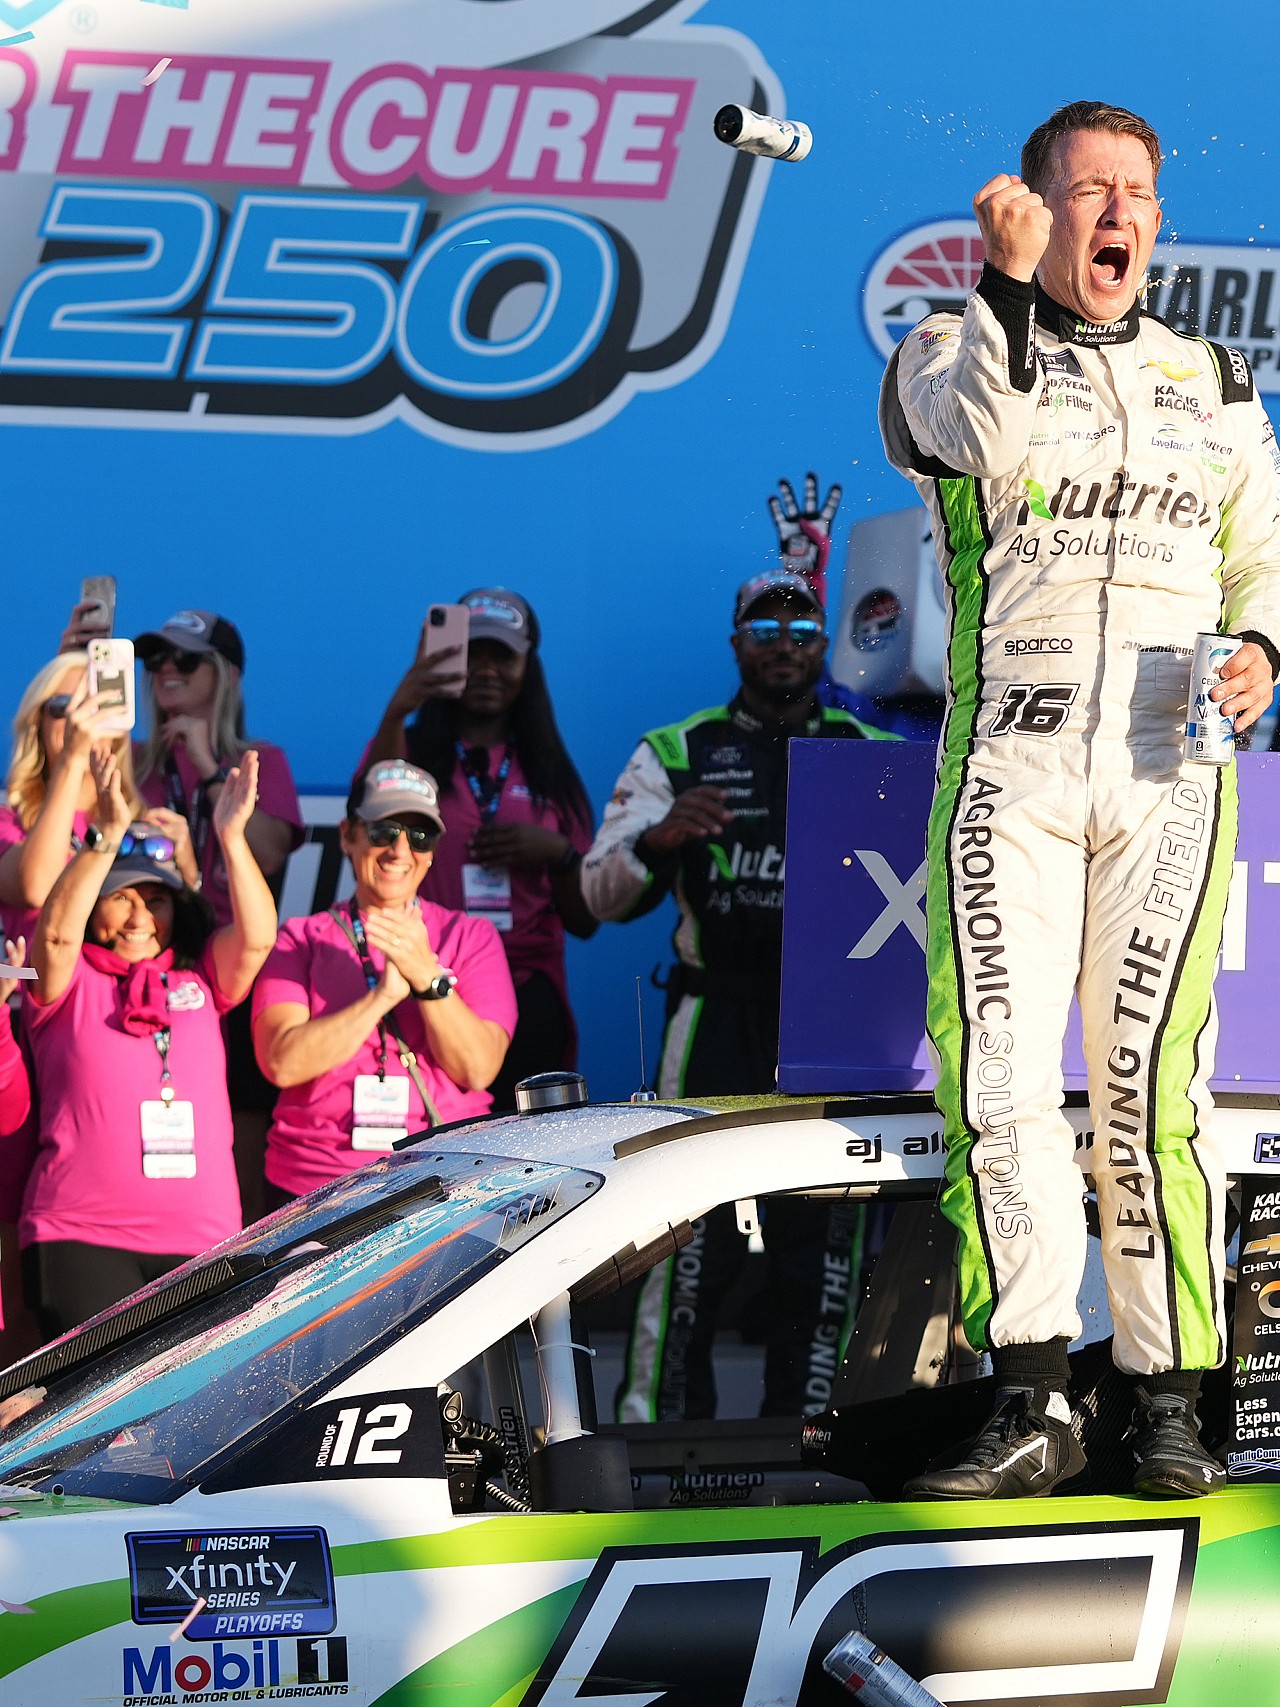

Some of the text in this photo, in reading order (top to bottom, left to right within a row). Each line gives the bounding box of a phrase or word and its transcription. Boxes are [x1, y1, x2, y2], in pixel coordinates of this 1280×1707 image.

[68, 62, 314, 169] THE
[340, 74, 679, 185] CURE
[2, 183, 619, 397] 250
[1075, 320, 1128, 335] Nutrien
[1004, 529, 1175, 563] Ag Solutions
[1004, 636, 1073, 656] sparco
[1122, 640, 1194, 656] Allmendinge
[988, 683, 1081, 738] 16
[958, 776, 1013, 1022] AGRONOMIC
[1107, 780, 1208, 1260] LEADING THE FIELD
[845, 1132, 883, 1164] aj
[803, 1323, 839, 1417] ADING
[821, 1252, 850, 1315] THE
[1233, 1374, 1248, 1388] Ag
[1235, 1397, 1269, 1413] Less
[315, 1424, 337, 1467] ROUND OF
[330, 1402, 413, 1467] 12
[690, 1487, 749, 1501] Solutions
[206, 1536, 270, 1551] NASCAR
[166, 1555, 297, 1599] xfinity
[206, 1592, 260, 1609] SERIES
[215, 1612, 304, 1634] PLAYOFFS
[123, 1639, 280, 1696] Mobil
[123, 1684, 349, 1707] OFFICIAL MOTOR OIL & LUBRICANTS
